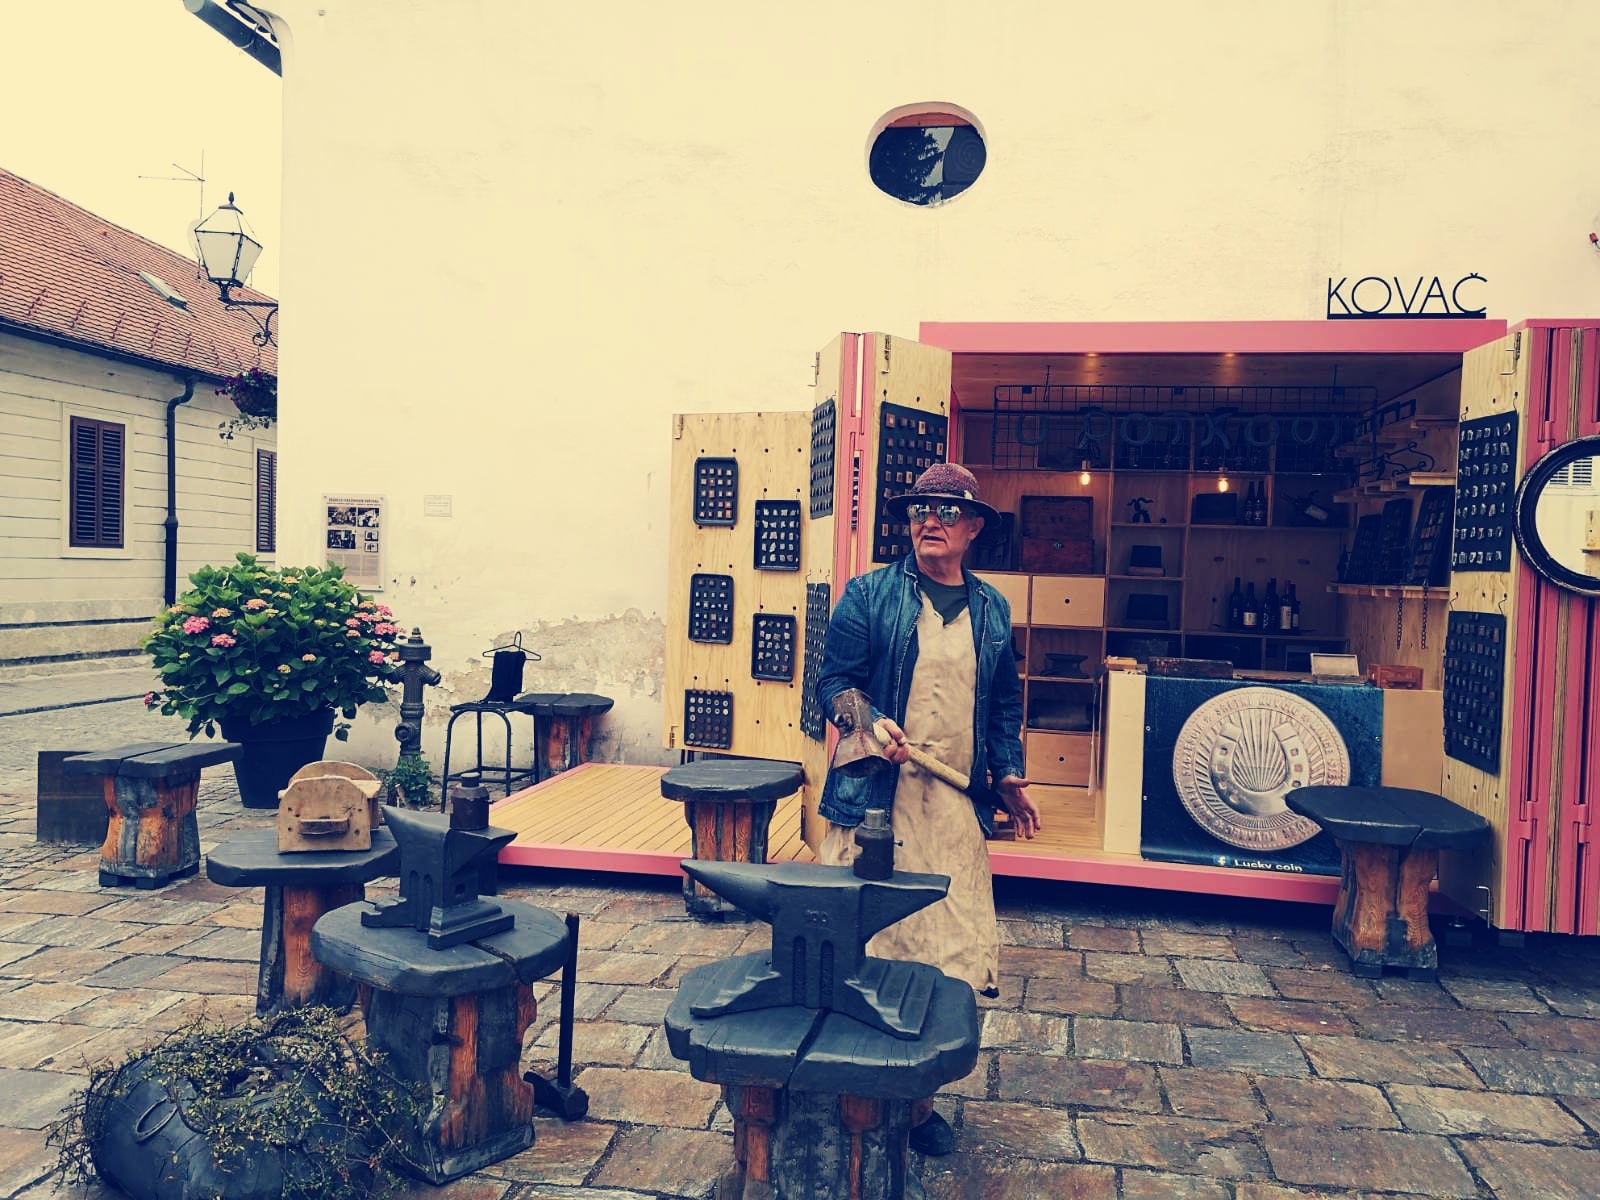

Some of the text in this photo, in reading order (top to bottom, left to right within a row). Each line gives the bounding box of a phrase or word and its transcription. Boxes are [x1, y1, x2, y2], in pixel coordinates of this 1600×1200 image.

[1327, 273, 1488, 317] KOVAČ
[1234, 859, 1272, 869] Lucky
[1275, 863, 1303, 872] coin
